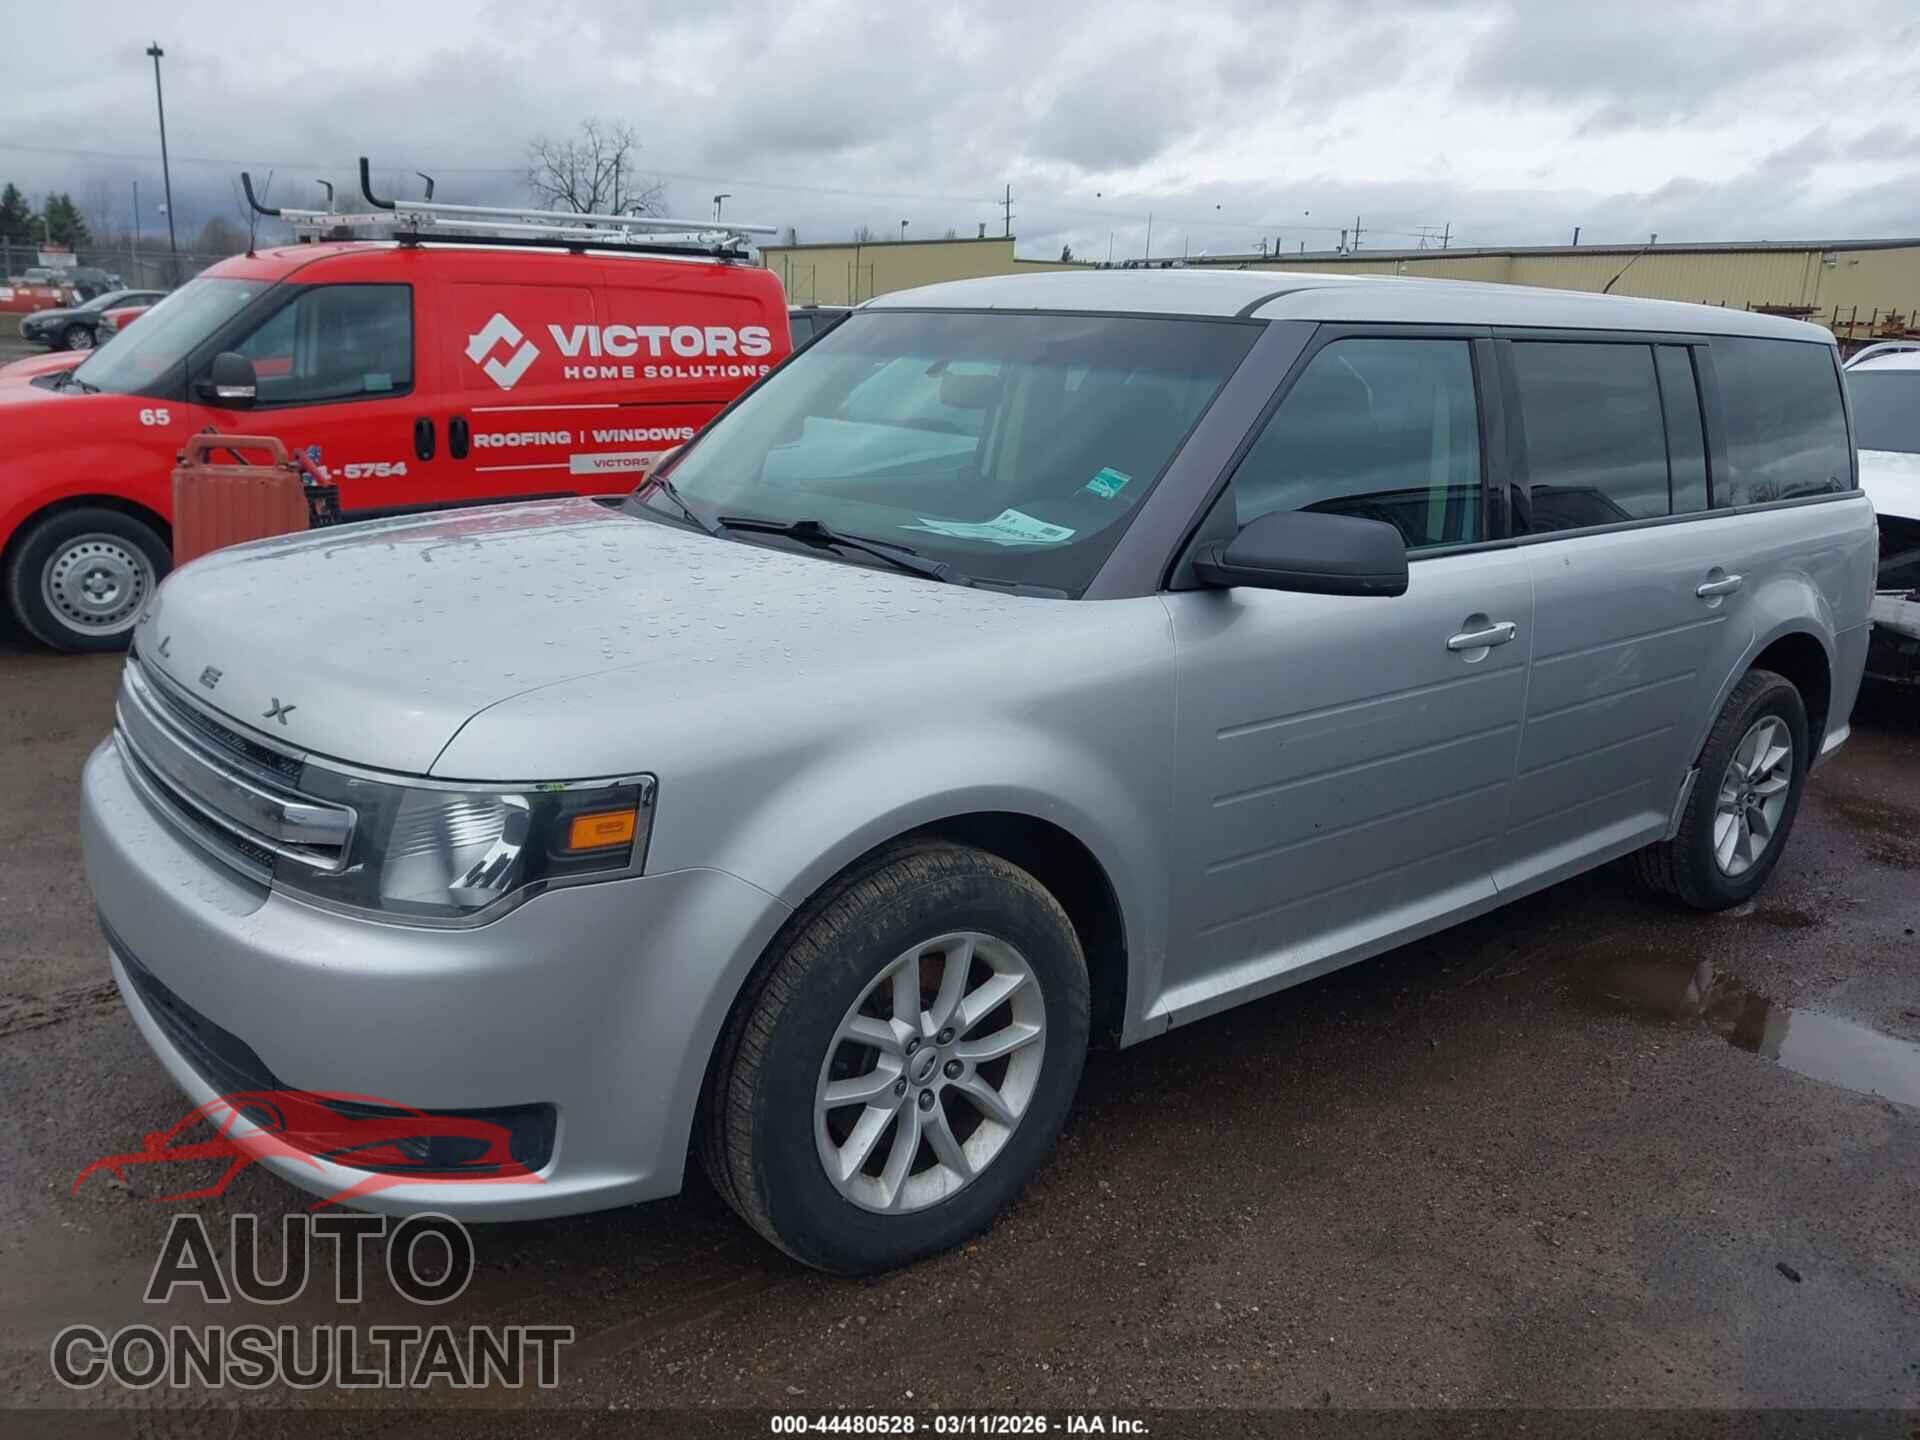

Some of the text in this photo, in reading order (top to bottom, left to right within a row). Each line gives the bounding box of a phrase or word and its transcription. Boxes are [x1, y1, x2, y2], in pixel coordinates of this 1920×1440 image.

[548, 324, 771, 357] VICTORS
[564, 364, 770, 379] HOME SOLUTIONS
[139, 409, 170, 426] 65
[473, 431, 572, 448] ROOFING
[592, 427, 694, 443] WINDOWS
